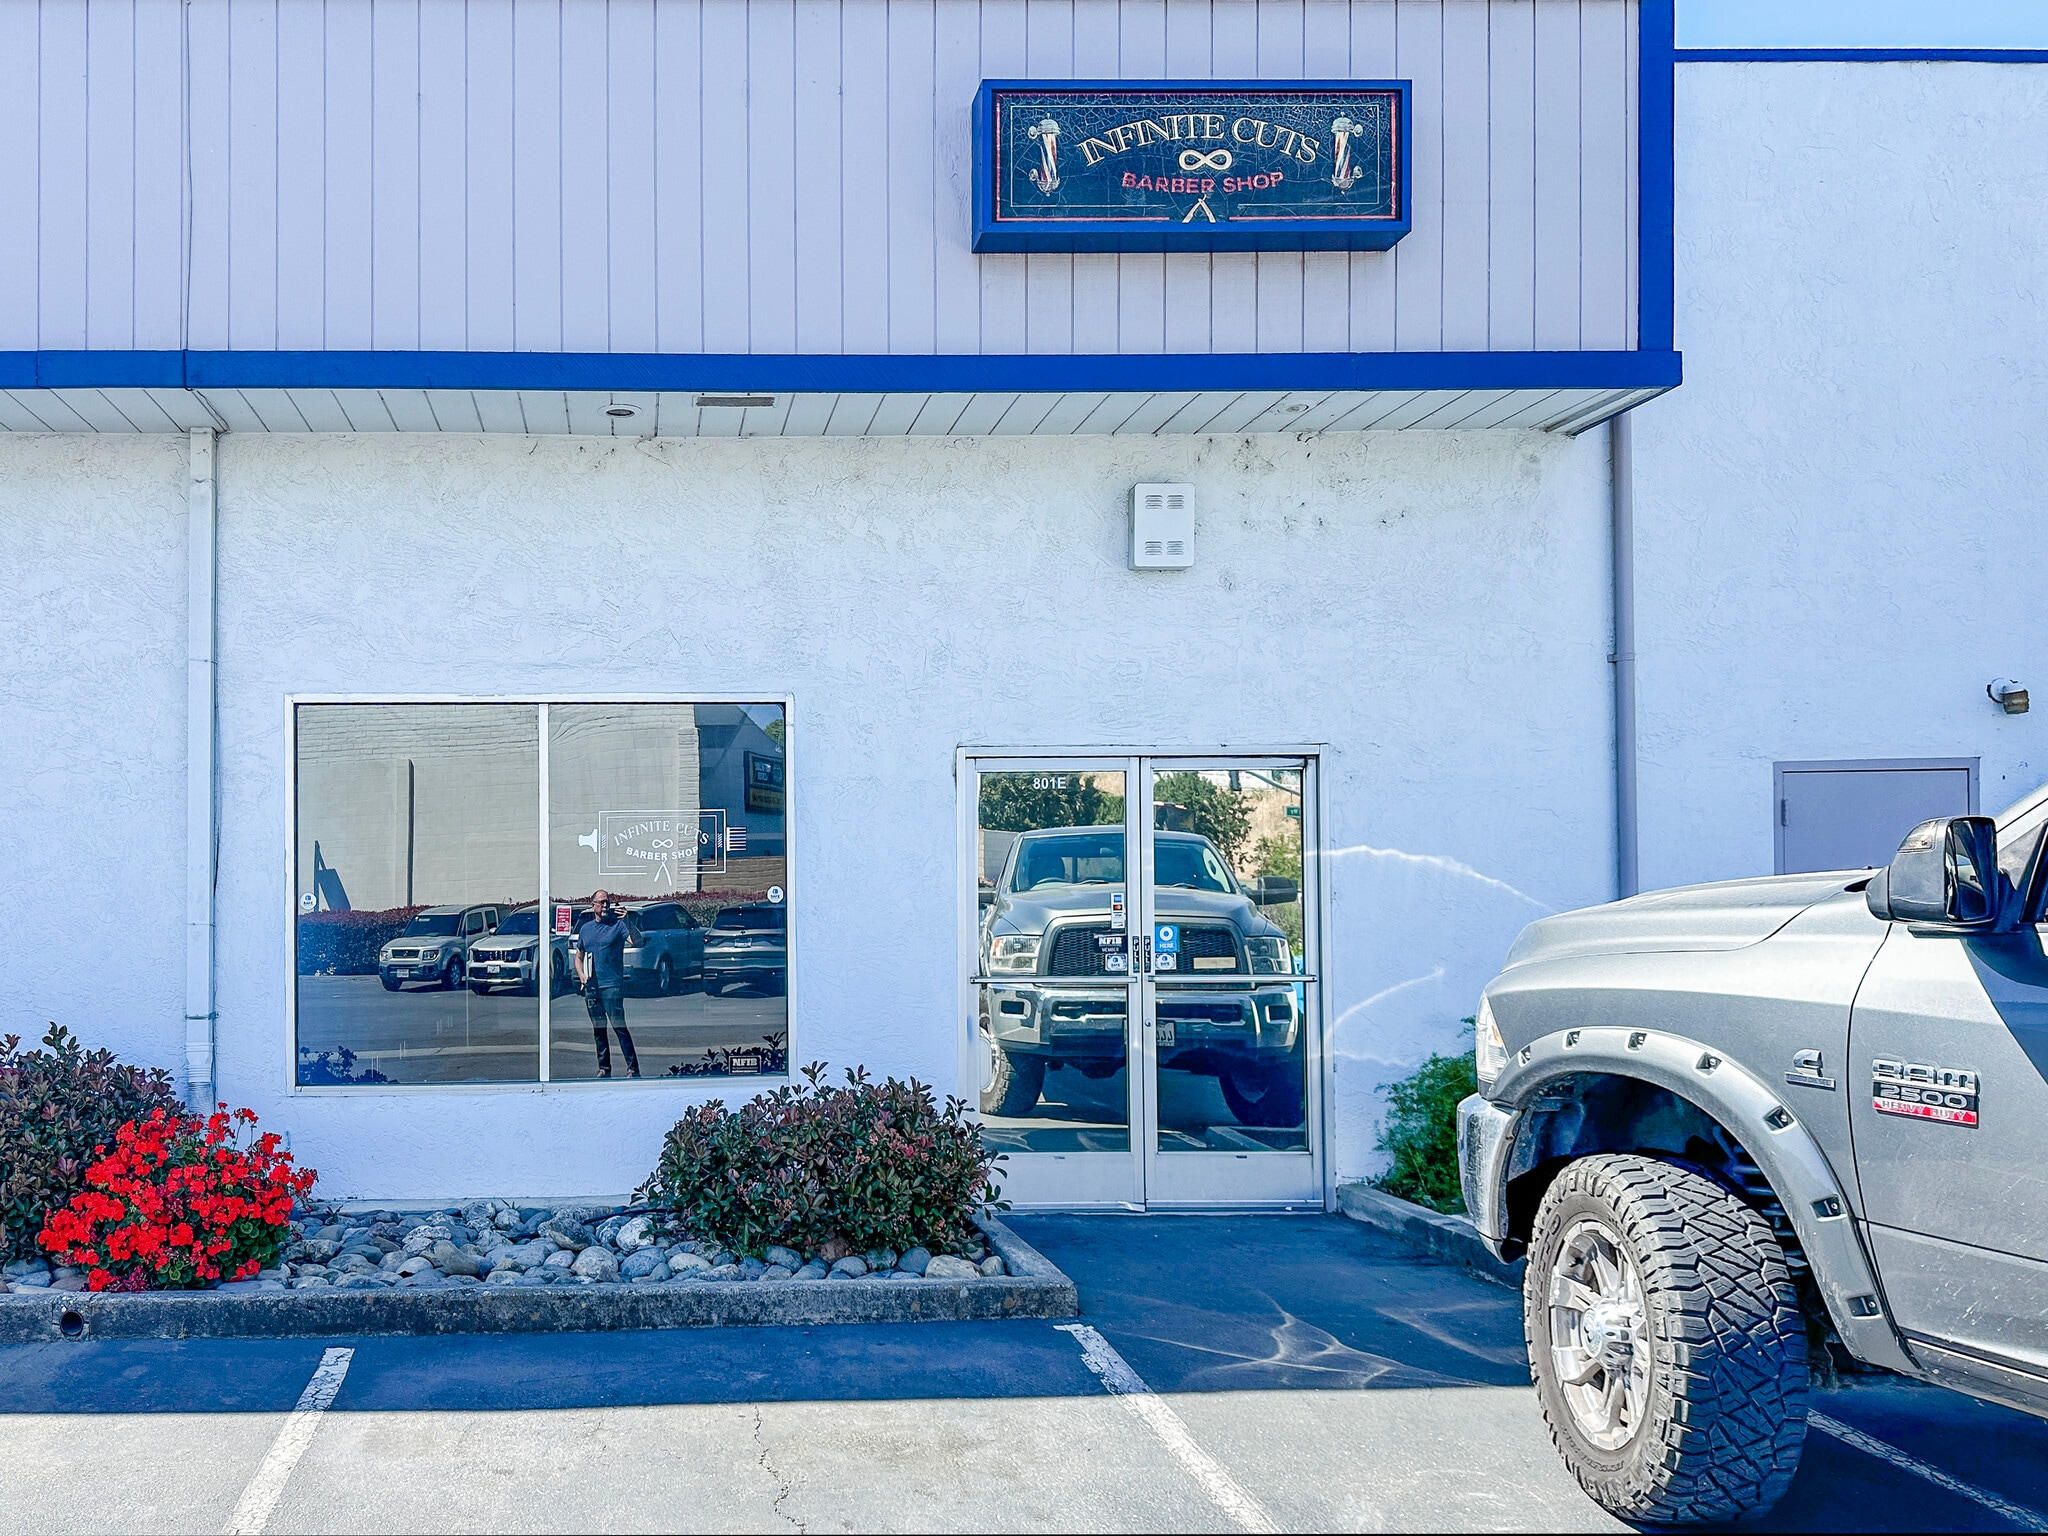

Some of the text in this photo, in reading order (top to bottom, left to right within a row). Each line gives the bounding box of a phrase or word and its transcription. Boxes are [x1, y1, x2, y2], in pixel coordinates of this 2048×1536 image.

[1076, 113, 1321, 167] INFINITE CUTS
[1121, 171, 1285, 194] BARBER SHOP
[1032, 776, 1067, 790] 801E
[613, 820, 710, 847] INFINITE CUTS
[625, 846, 699, 862] BARBER SHOP
[1098, 937, 1122, 945] NFIB
[732, 1058, 757, 1066] NFIB
[1872, 1057, 1979, 1092] RAM
[1880, 1084, 1968, 1109] 2500
[1881, 1100, 1968, 1121] HEAVY DUTY
